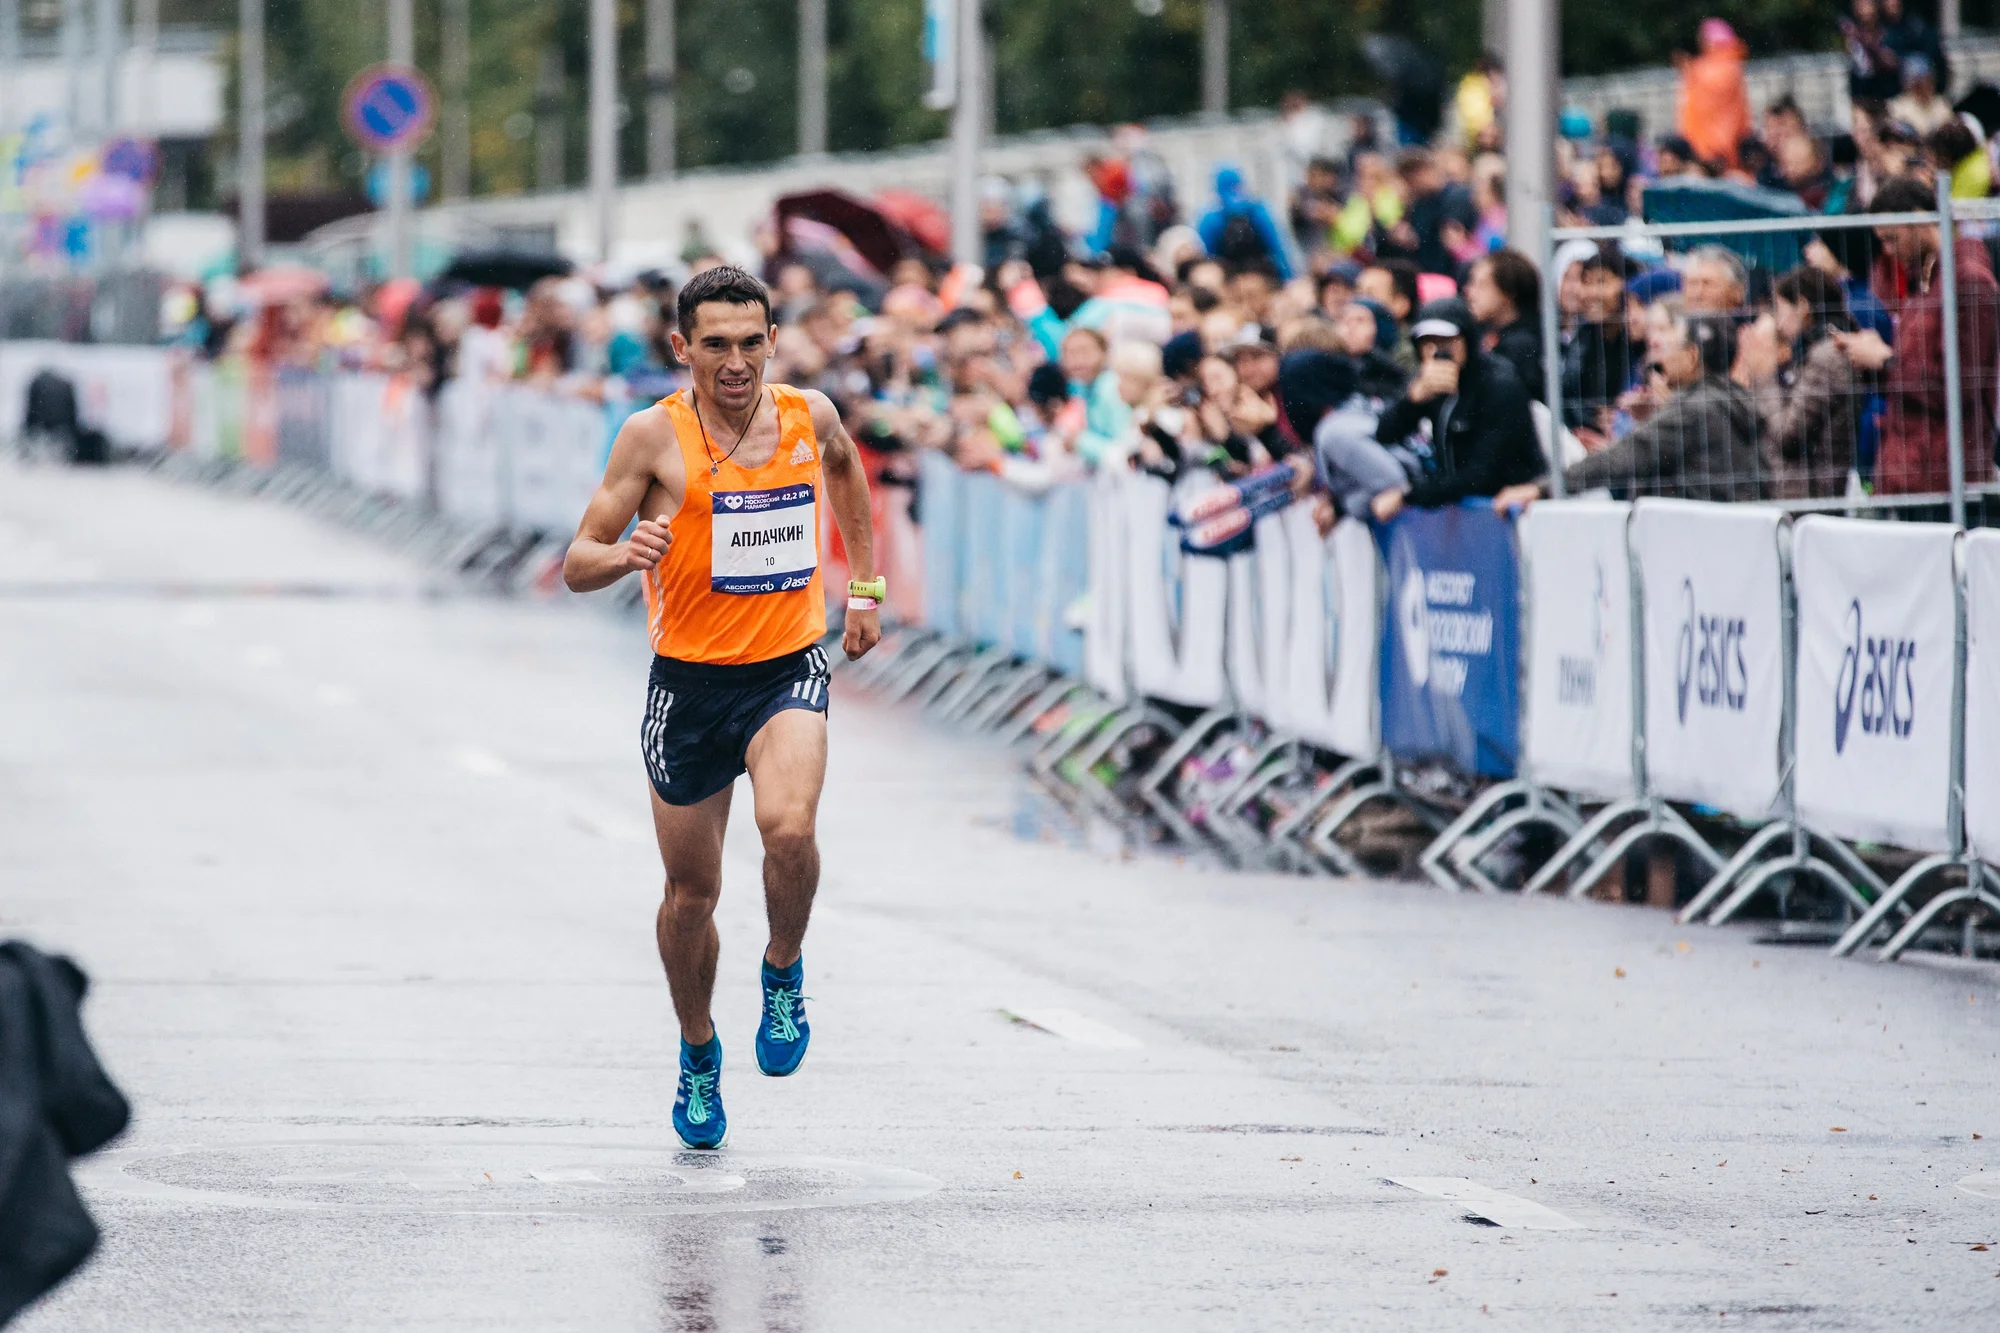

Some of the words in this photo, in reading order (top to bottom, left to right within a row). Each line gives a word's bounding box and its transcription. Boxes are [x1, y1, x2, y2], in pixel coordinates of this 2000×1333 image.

[781, 492, 798, 501] 42,2
[730, 524, 804, 547] АПЛАЧКИН
[765, 556, 775, 567] 10
